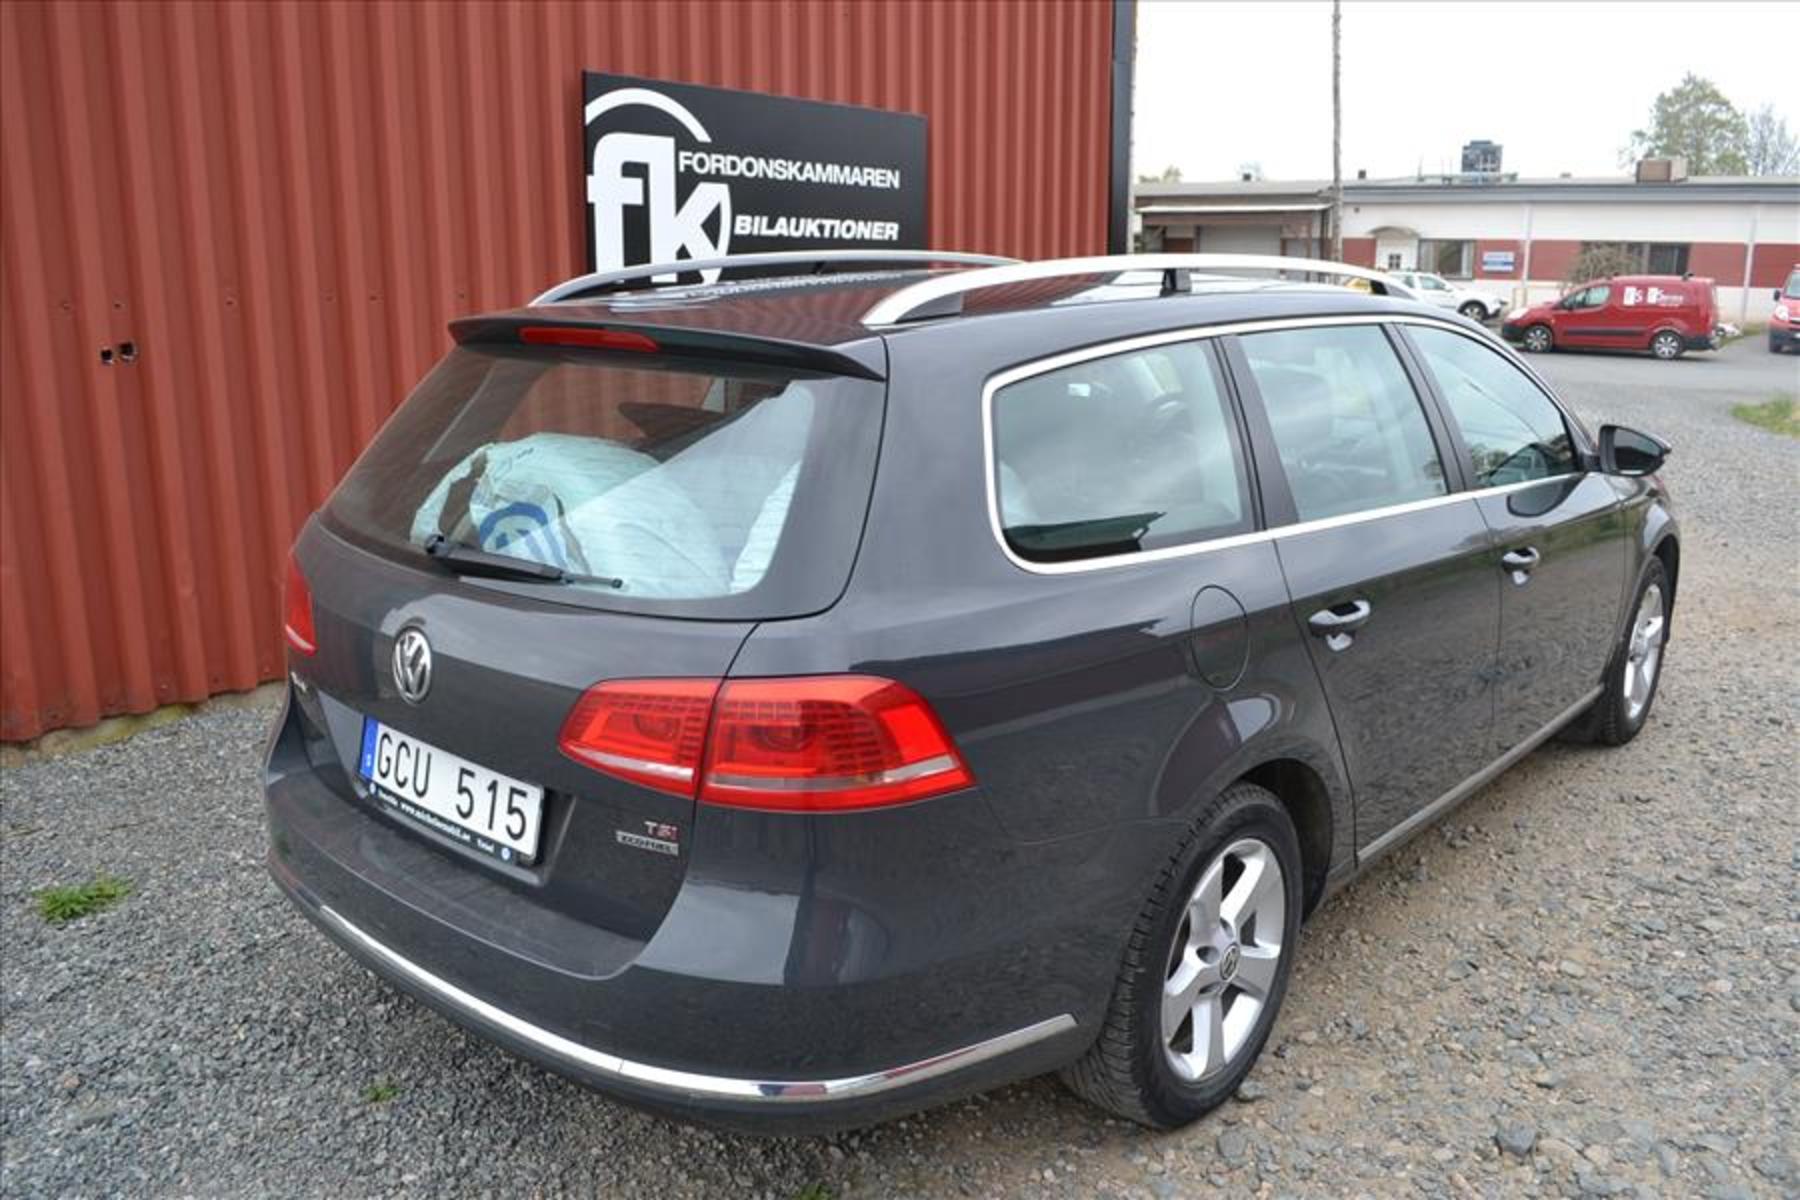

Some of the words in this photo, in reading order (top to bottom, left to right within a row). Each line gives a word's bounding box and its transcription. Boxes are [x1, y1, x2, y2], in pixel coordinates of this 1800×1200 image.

[679, 151, 899, 189] FORDONSKAMMAREN
[734, 215, 899, 241] BILAUKTIONER
[378, 733, 431, 798] GCU
[456, 766, 528, 840] 515
